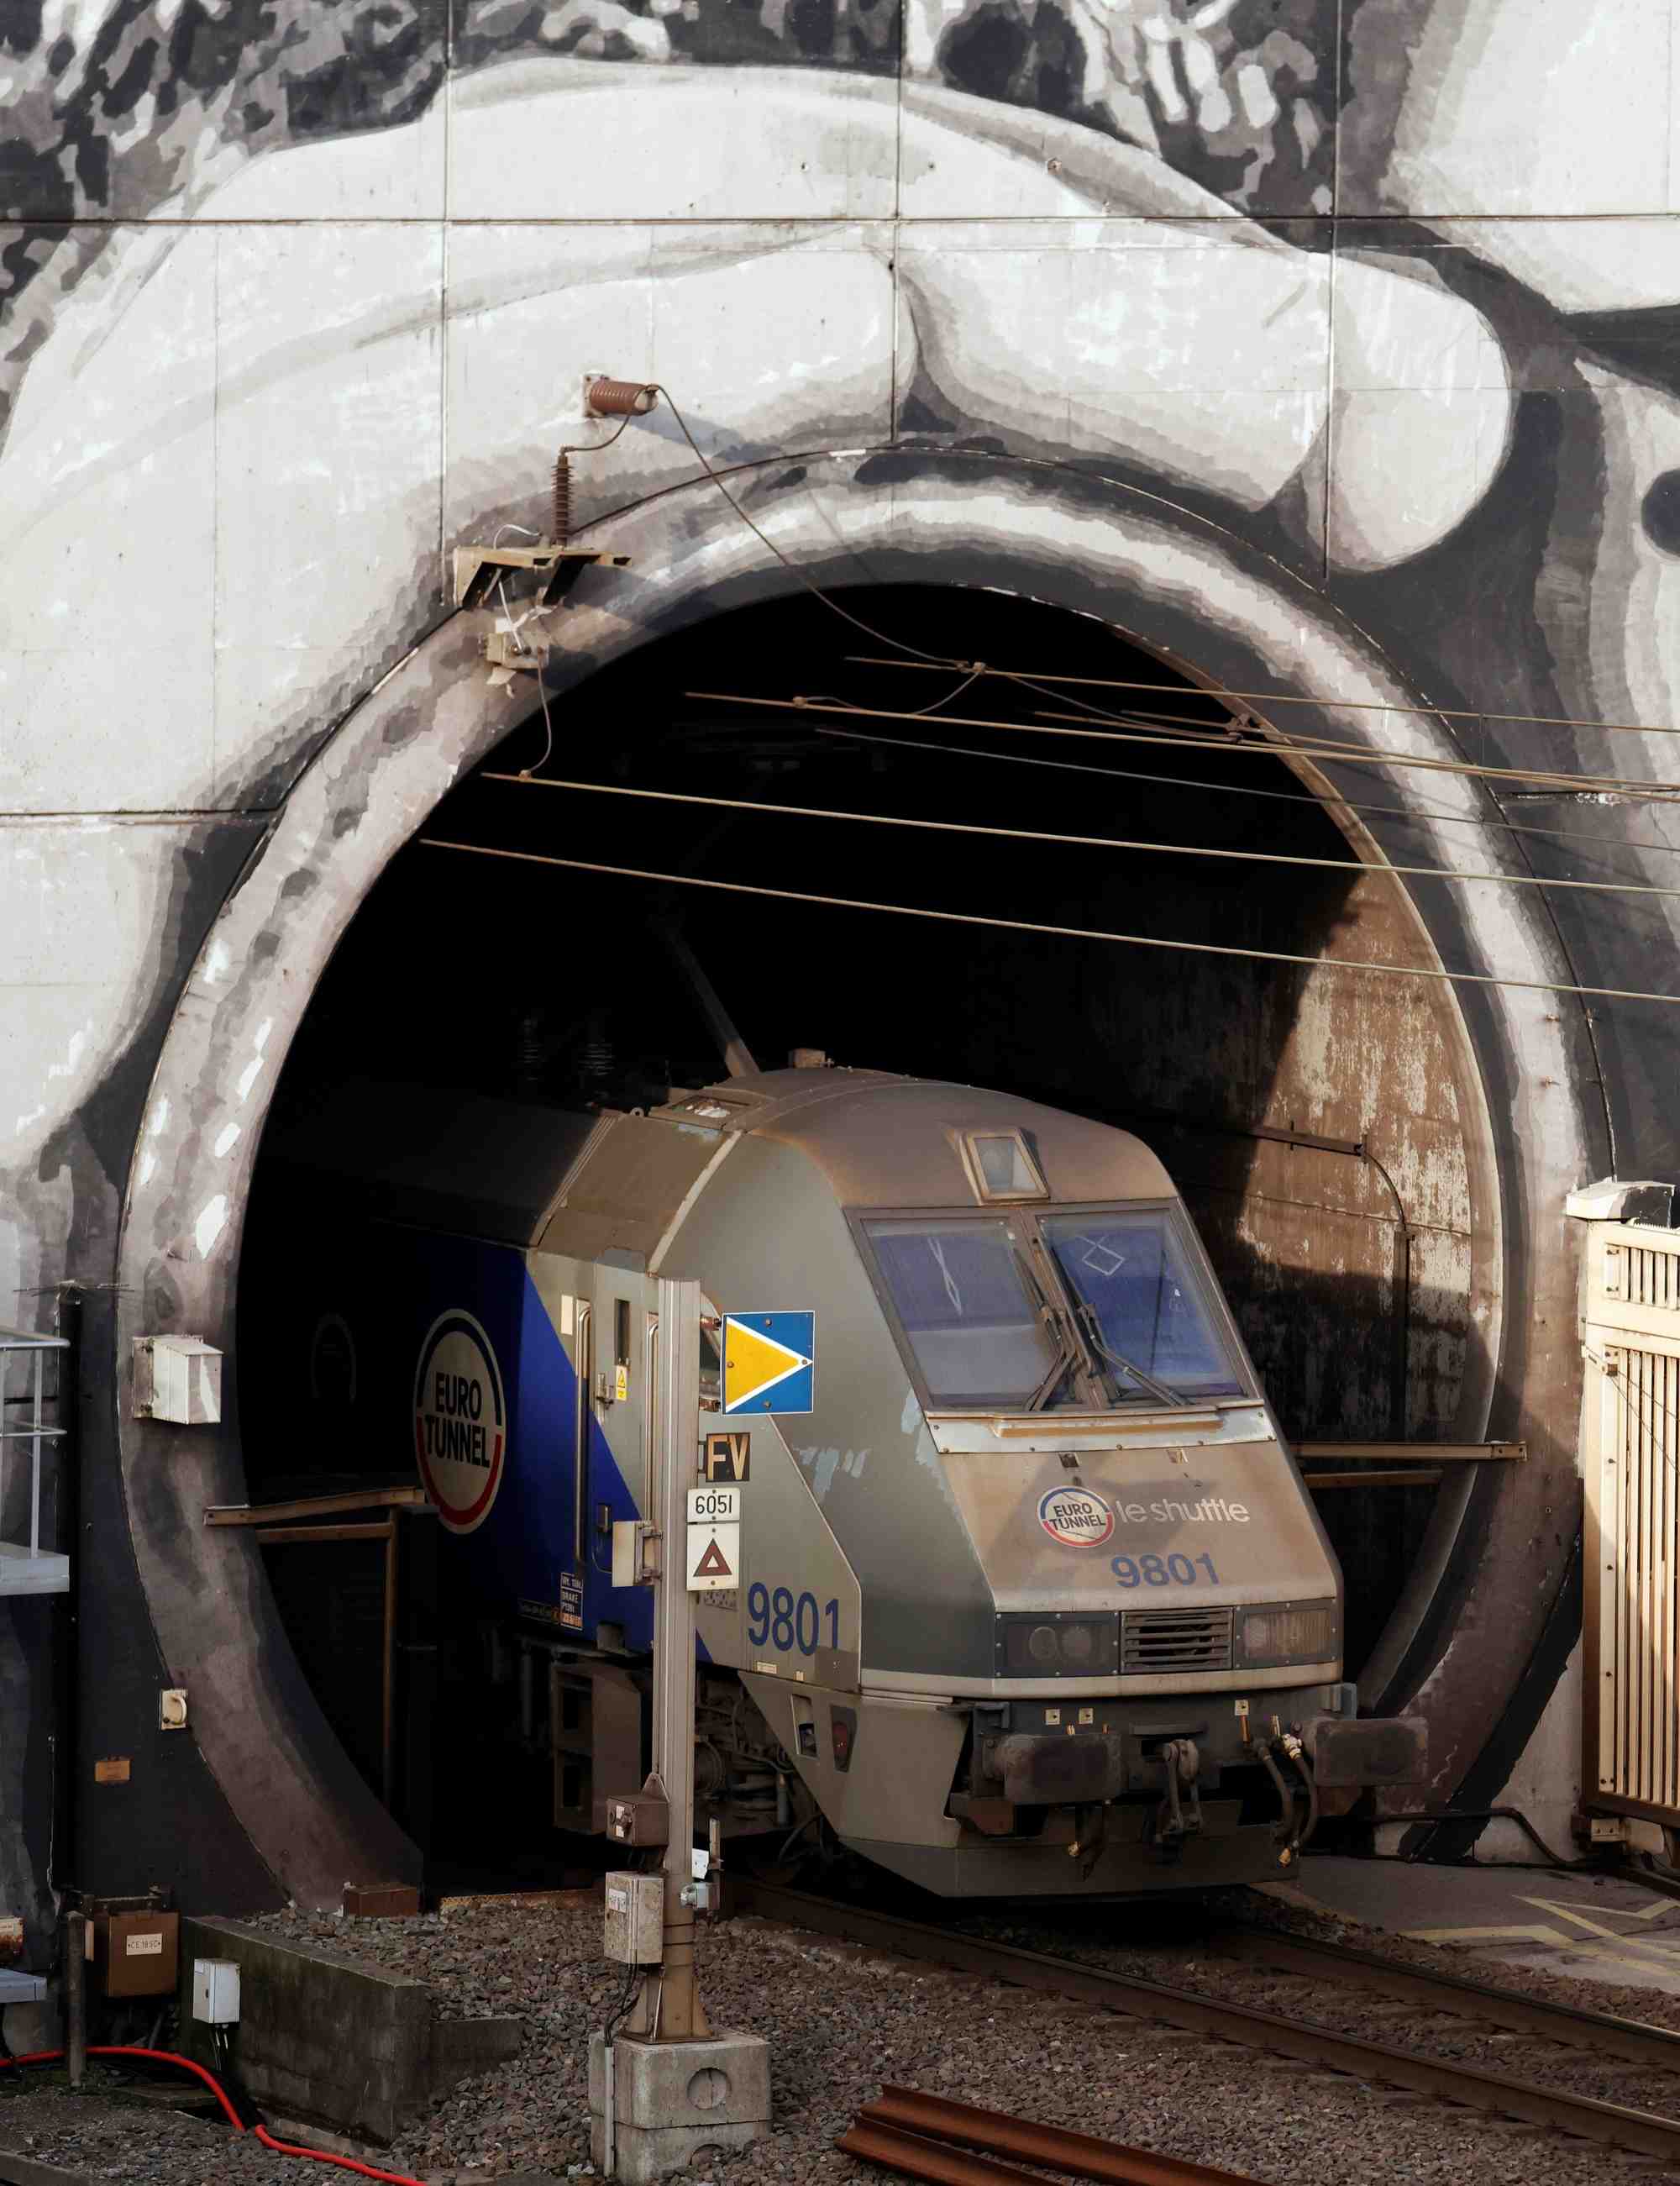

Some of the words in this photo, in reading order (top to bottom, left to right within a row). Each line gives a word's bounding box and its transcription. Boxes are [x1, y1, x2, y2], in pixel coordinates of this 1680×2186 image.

[435, 1372, 482, 1421] EURO
[424, 1416, 490, 1469] TUNNEL
[707, 1433, 750, 1480] FV
[696, 1495, 732, 1516] 6051
[1054, 1502, 1093, 1518] EURO
[1152, 1498, 1251, 1522] shuttle
[1049, 1516, 1106, 1532] TUNNEL
[1110, 1553, 1220, 1589] 9801
[748, 1581, 839, 1657] 9801
